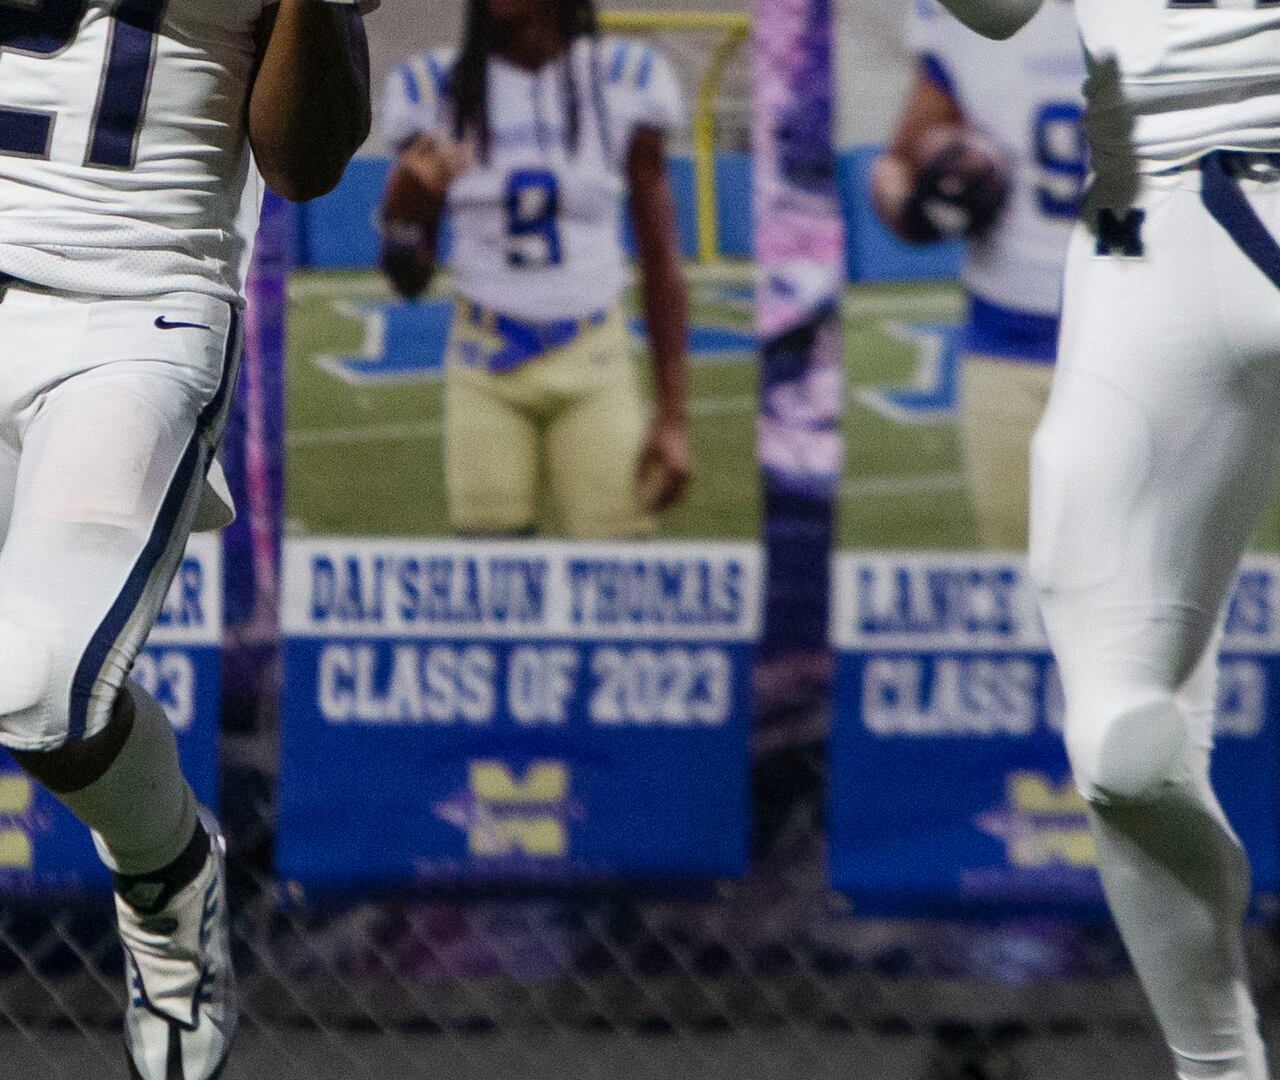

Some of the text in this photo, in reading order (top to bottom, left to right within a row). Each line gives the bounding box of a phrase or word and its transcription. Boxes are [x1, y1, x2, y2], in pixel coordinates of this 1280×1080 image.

[1096, 208, 1145, 256] M
[567, 558, 745, 626] THOMAS
[320, 646, 732, 726] CLASS OF 2023
[862, 656, 1039, 737] CLASS
